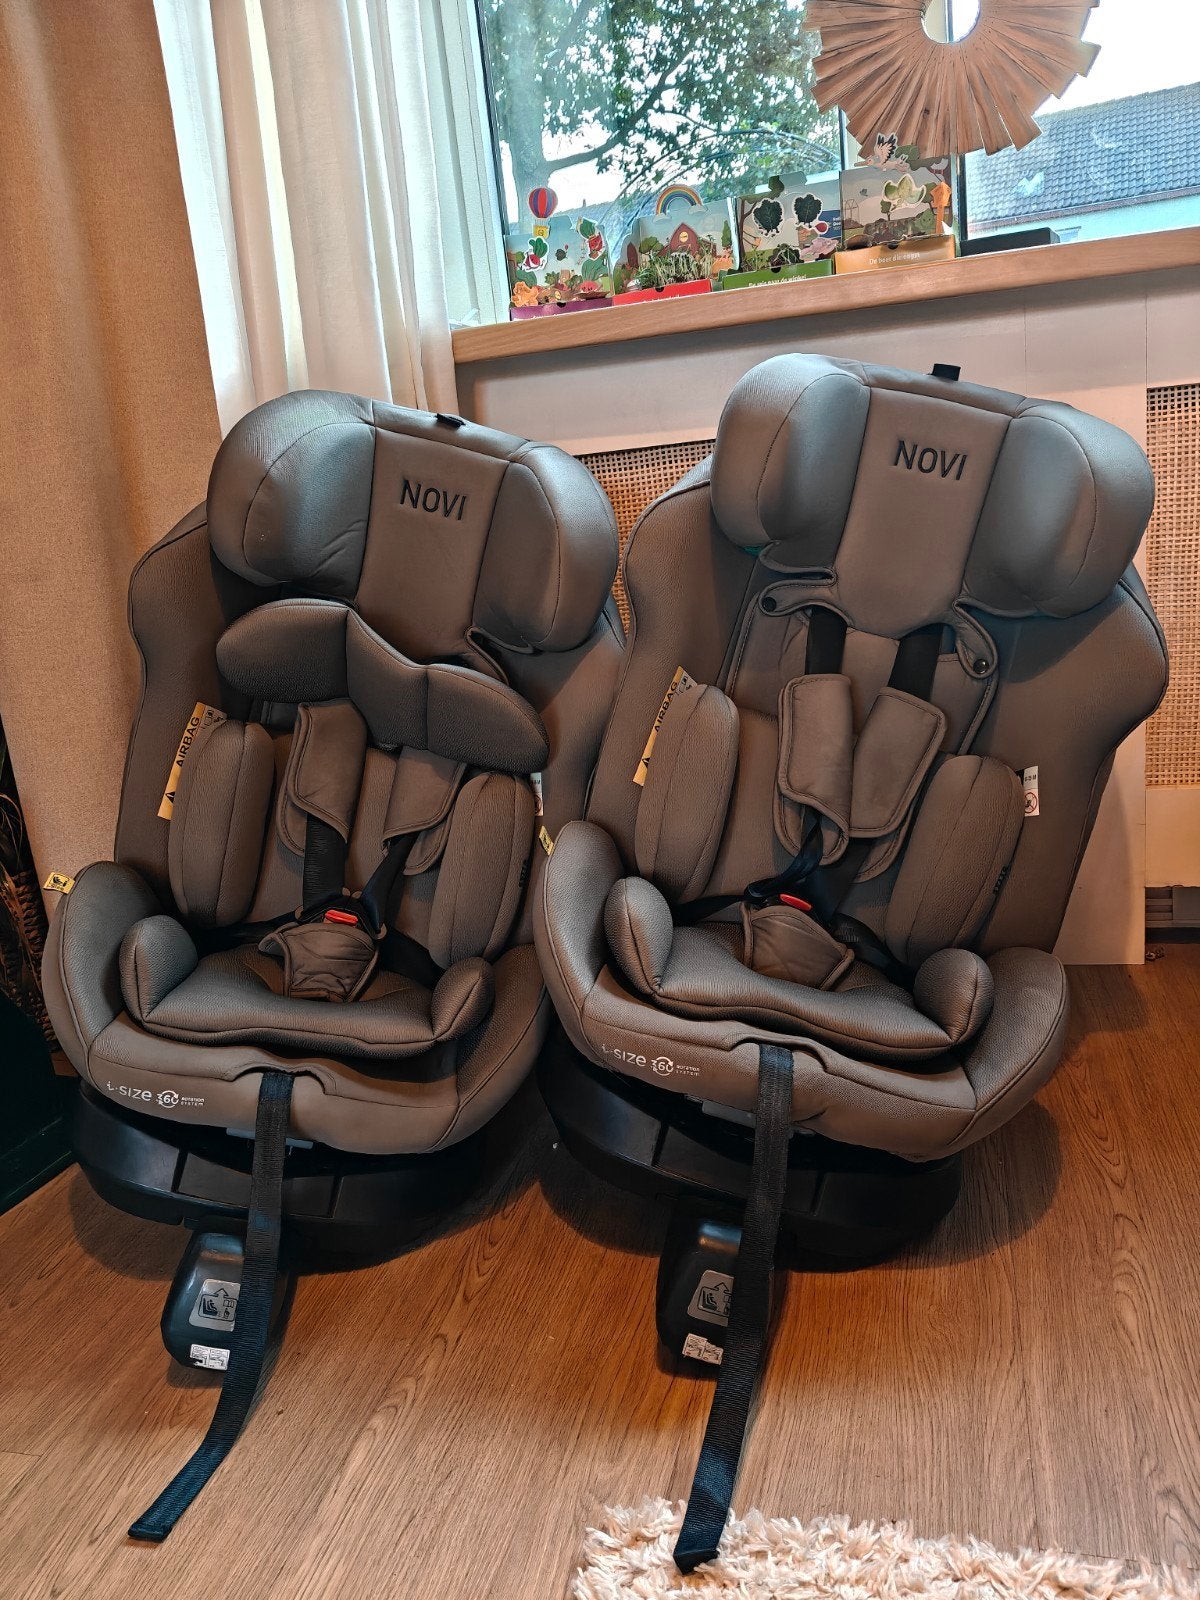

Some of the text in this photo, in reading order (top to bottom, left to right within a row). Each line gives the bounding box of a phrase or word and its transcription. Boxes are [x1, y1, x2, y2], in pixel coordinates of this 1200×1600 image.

[893, 440, 968, 481] NOVI
[399, 479, 467, 521] NOVI
[654, 681, 678, 733] AIRBAG
[175, 716, 200, 768] AIRBAG
